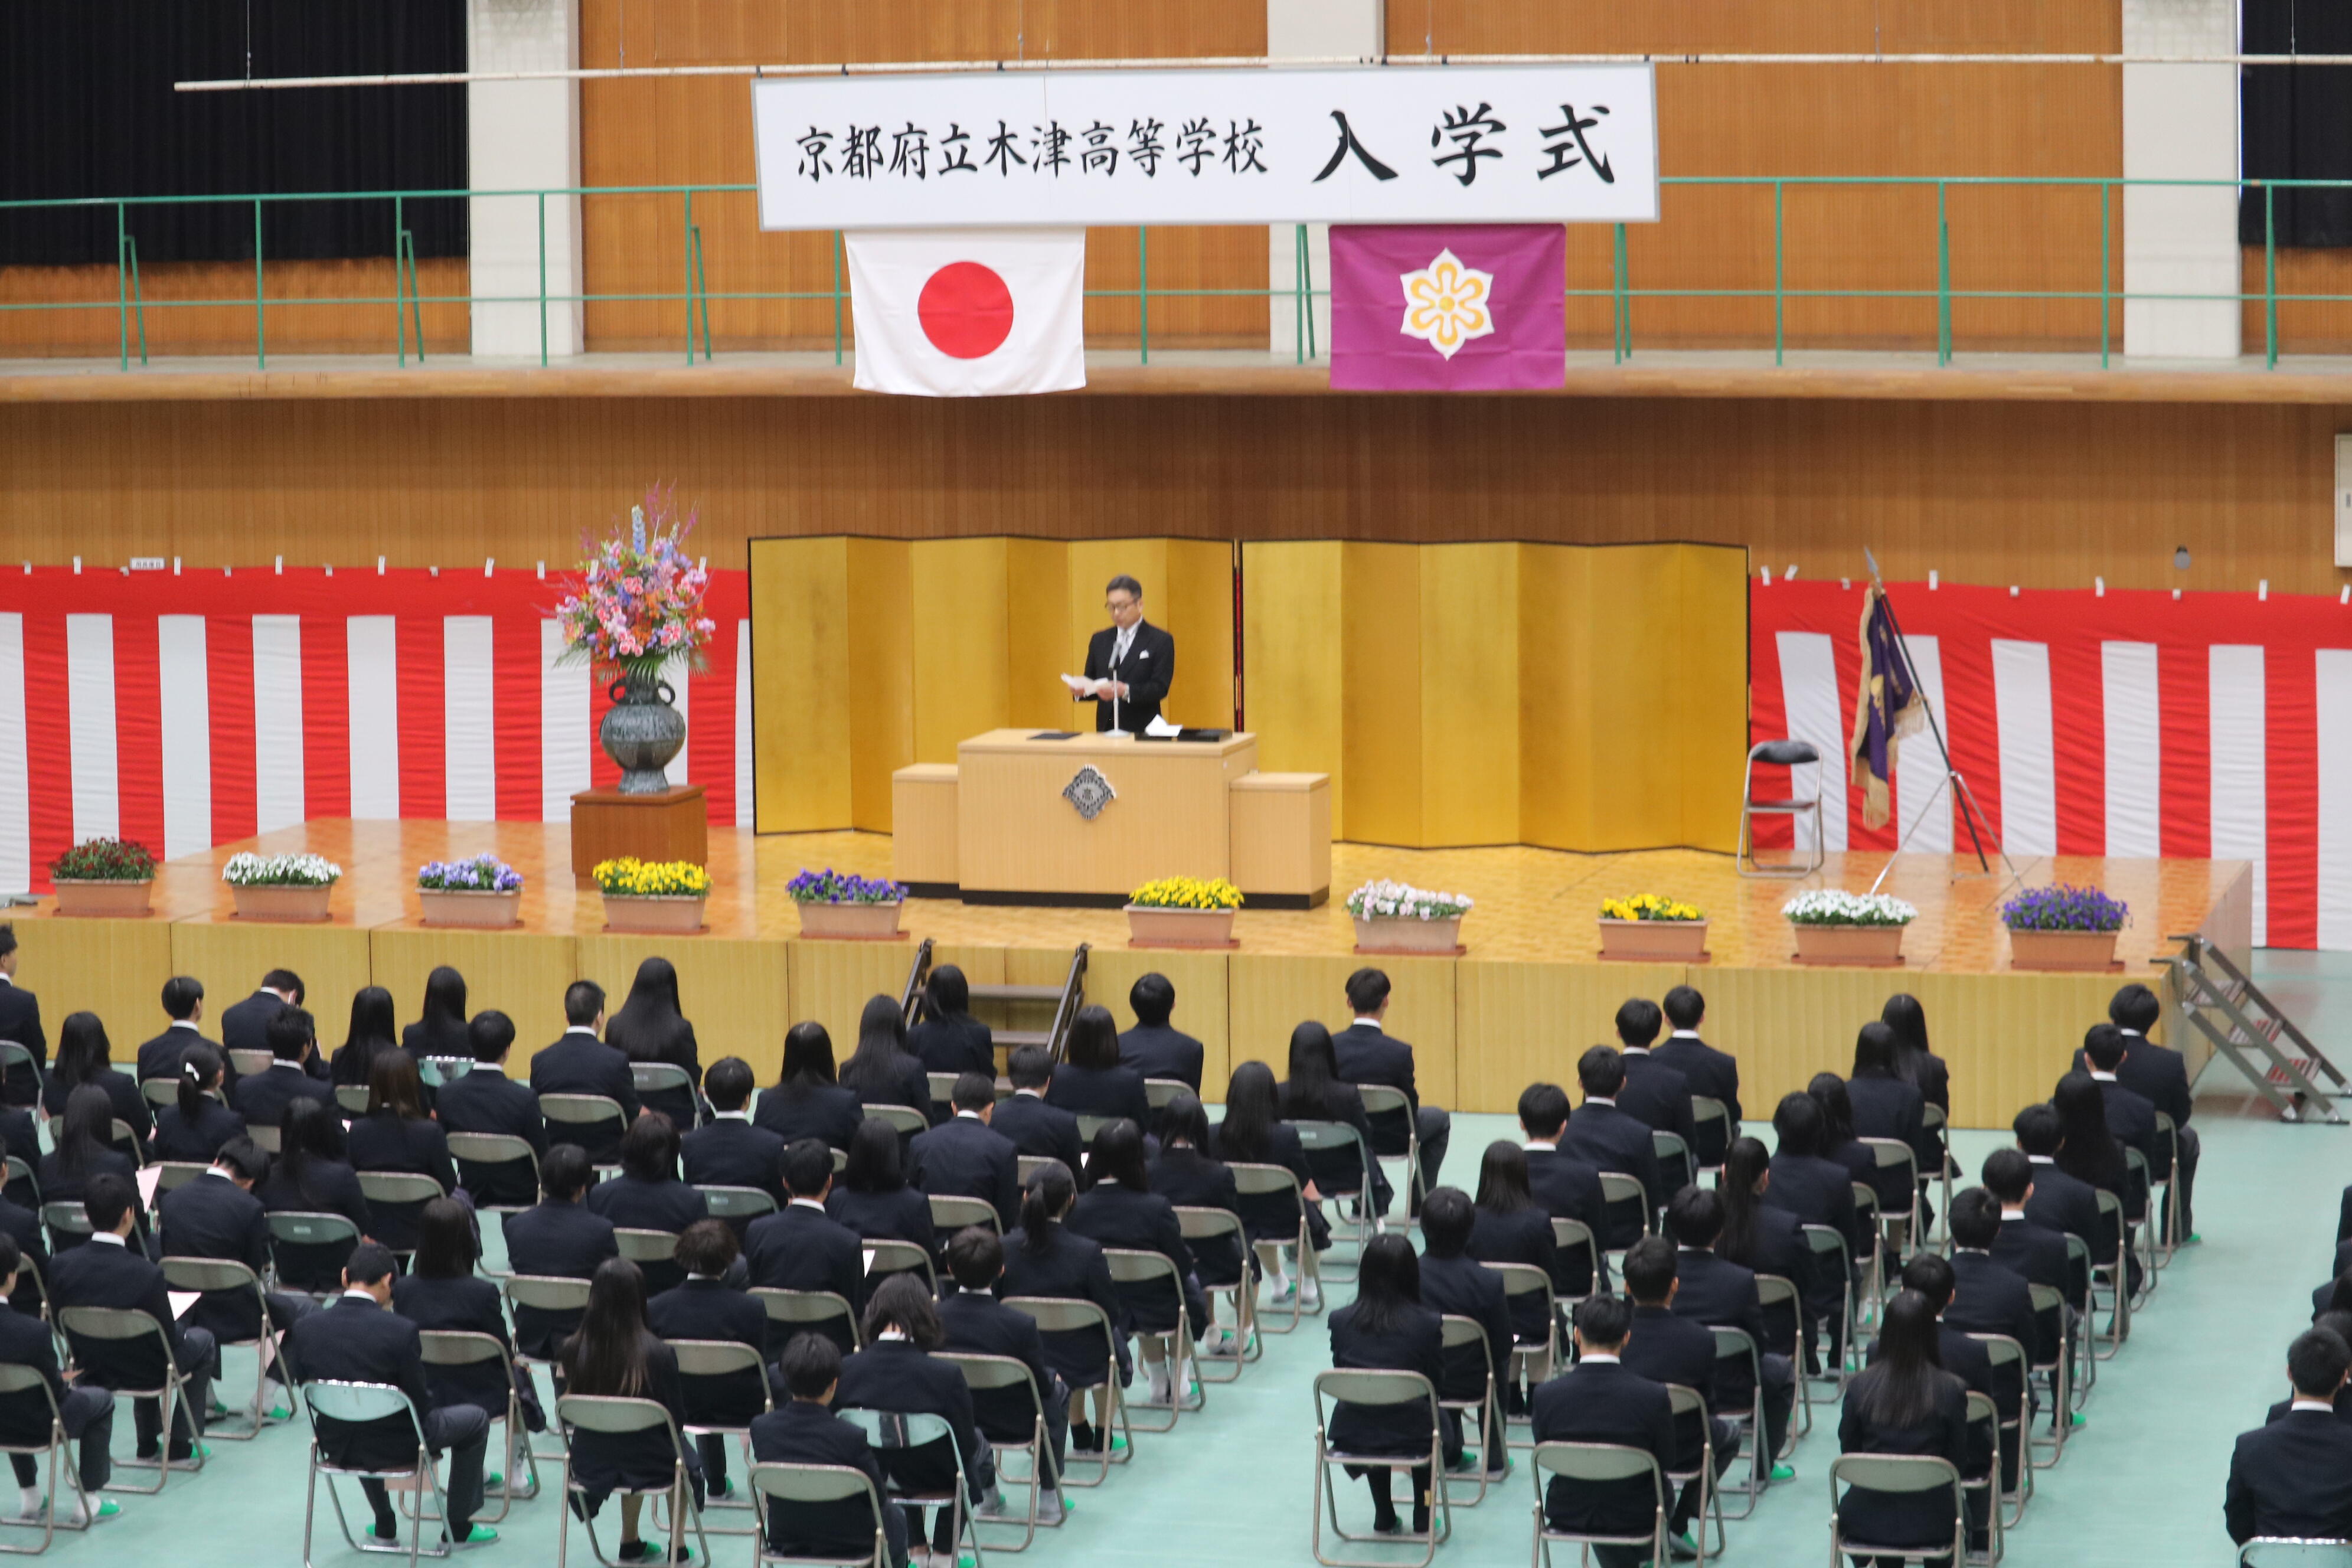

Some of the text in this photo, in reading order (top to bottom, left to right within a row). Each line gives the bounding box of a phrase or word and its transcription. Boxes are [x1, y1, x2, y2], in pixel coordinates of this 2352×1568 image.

[795, 102, 1615, 187] 京都府立木津高等学校 入学式
